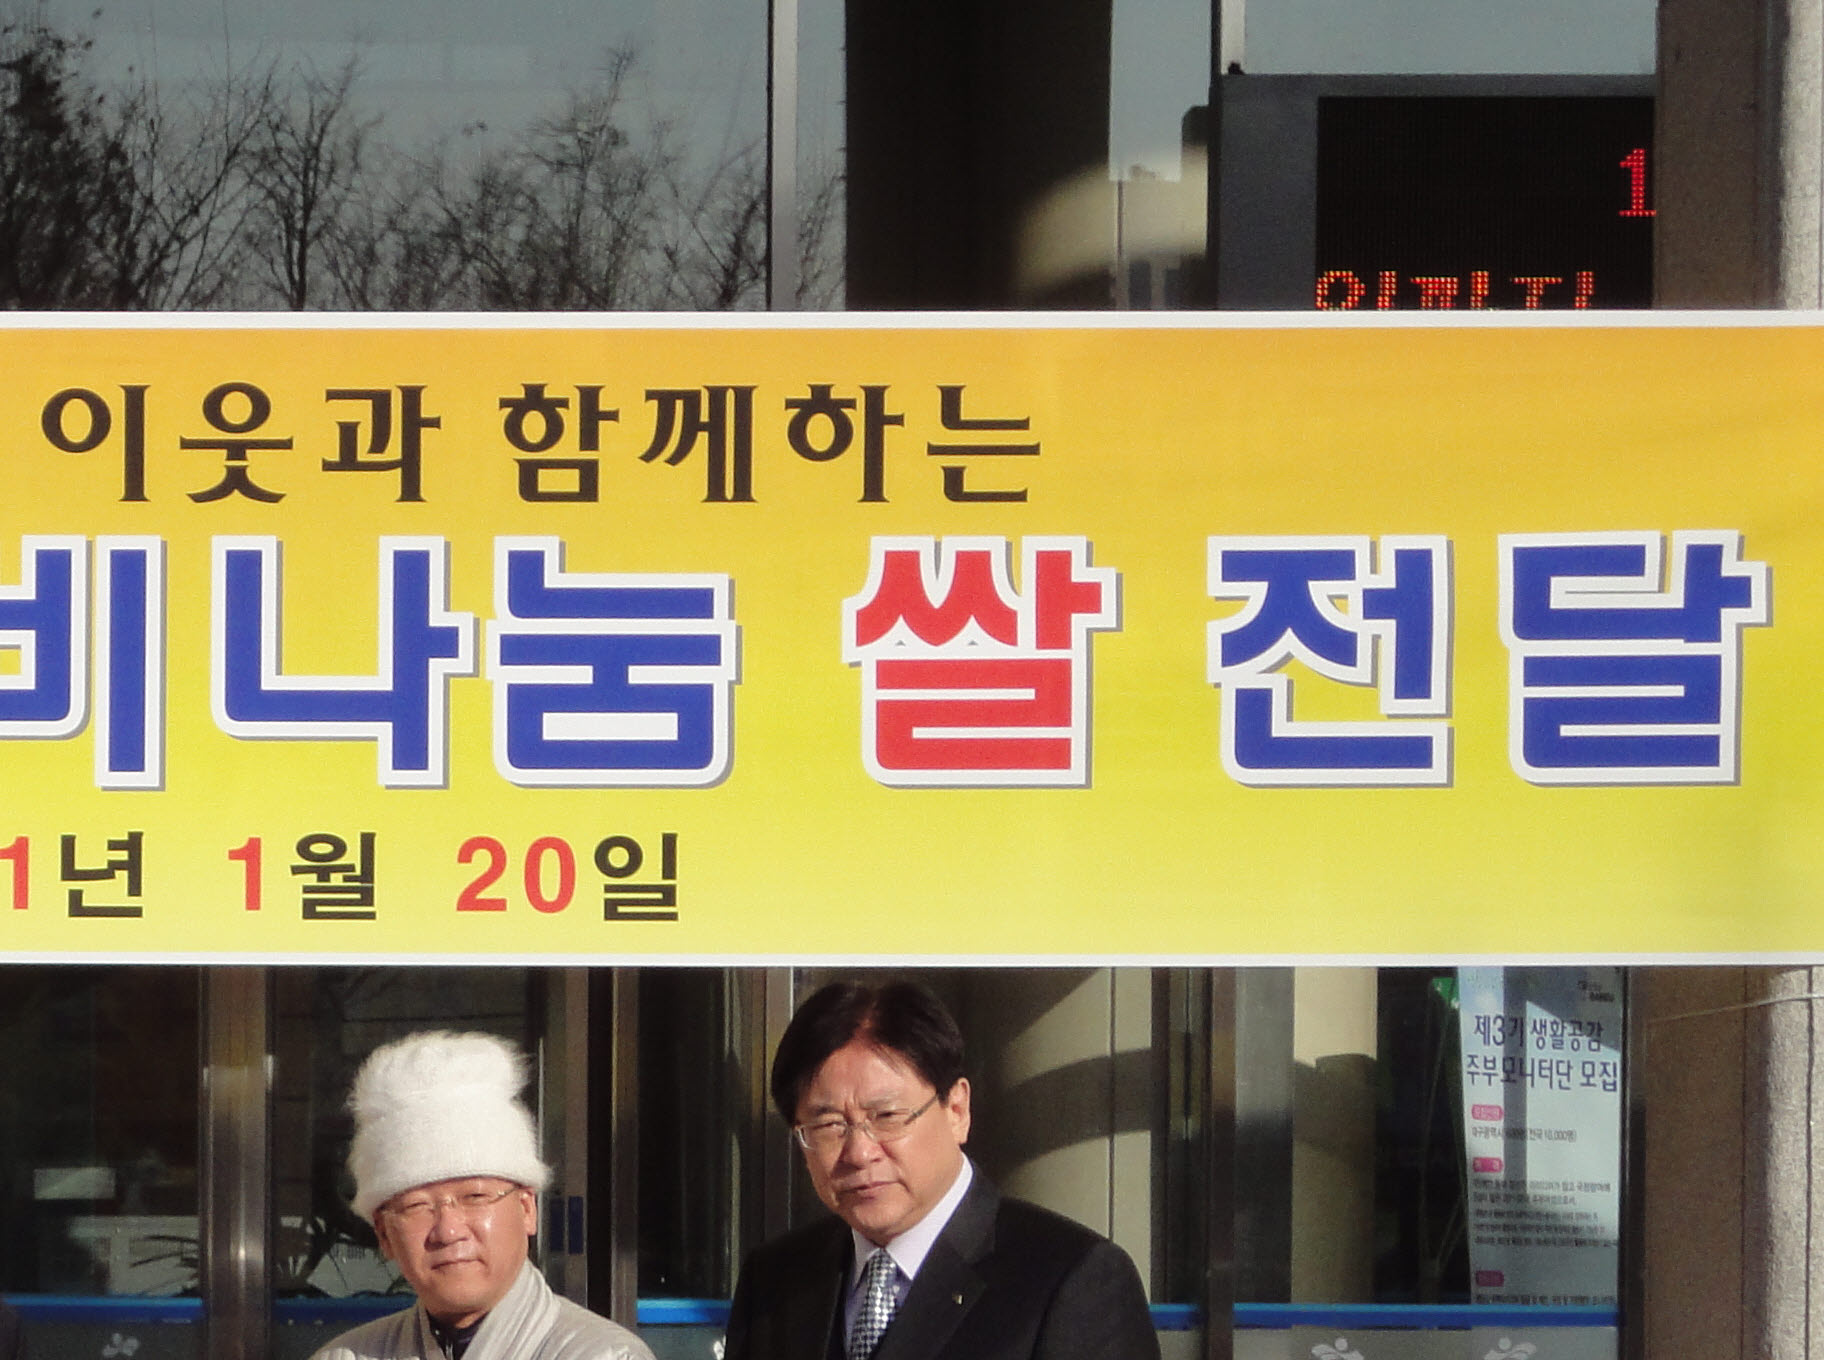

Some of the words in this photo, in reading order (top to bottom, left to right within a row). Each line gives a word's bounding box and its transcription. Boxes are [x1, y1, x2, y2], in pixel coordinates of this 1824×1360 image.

[1618, 147, 1657, 217] 1
[41, 384, 441, 503] 이웃과
[498, 384, 1039, 502] 함께하는
[844, 535, 1120, 785] 쌀
[1208, 530, 1764, 783] 전달
[226, 832, 377, 921] 1월
[455, 832, 678, 921] 20일
[1465, 1053, 1573, 1091] 주부모니터단
[1579, 1059, 1618, 1093] 모집
[1474, 1014, 1524, 1047] 제3기
[1530, 1018, 1605, 1053] 생활공감
